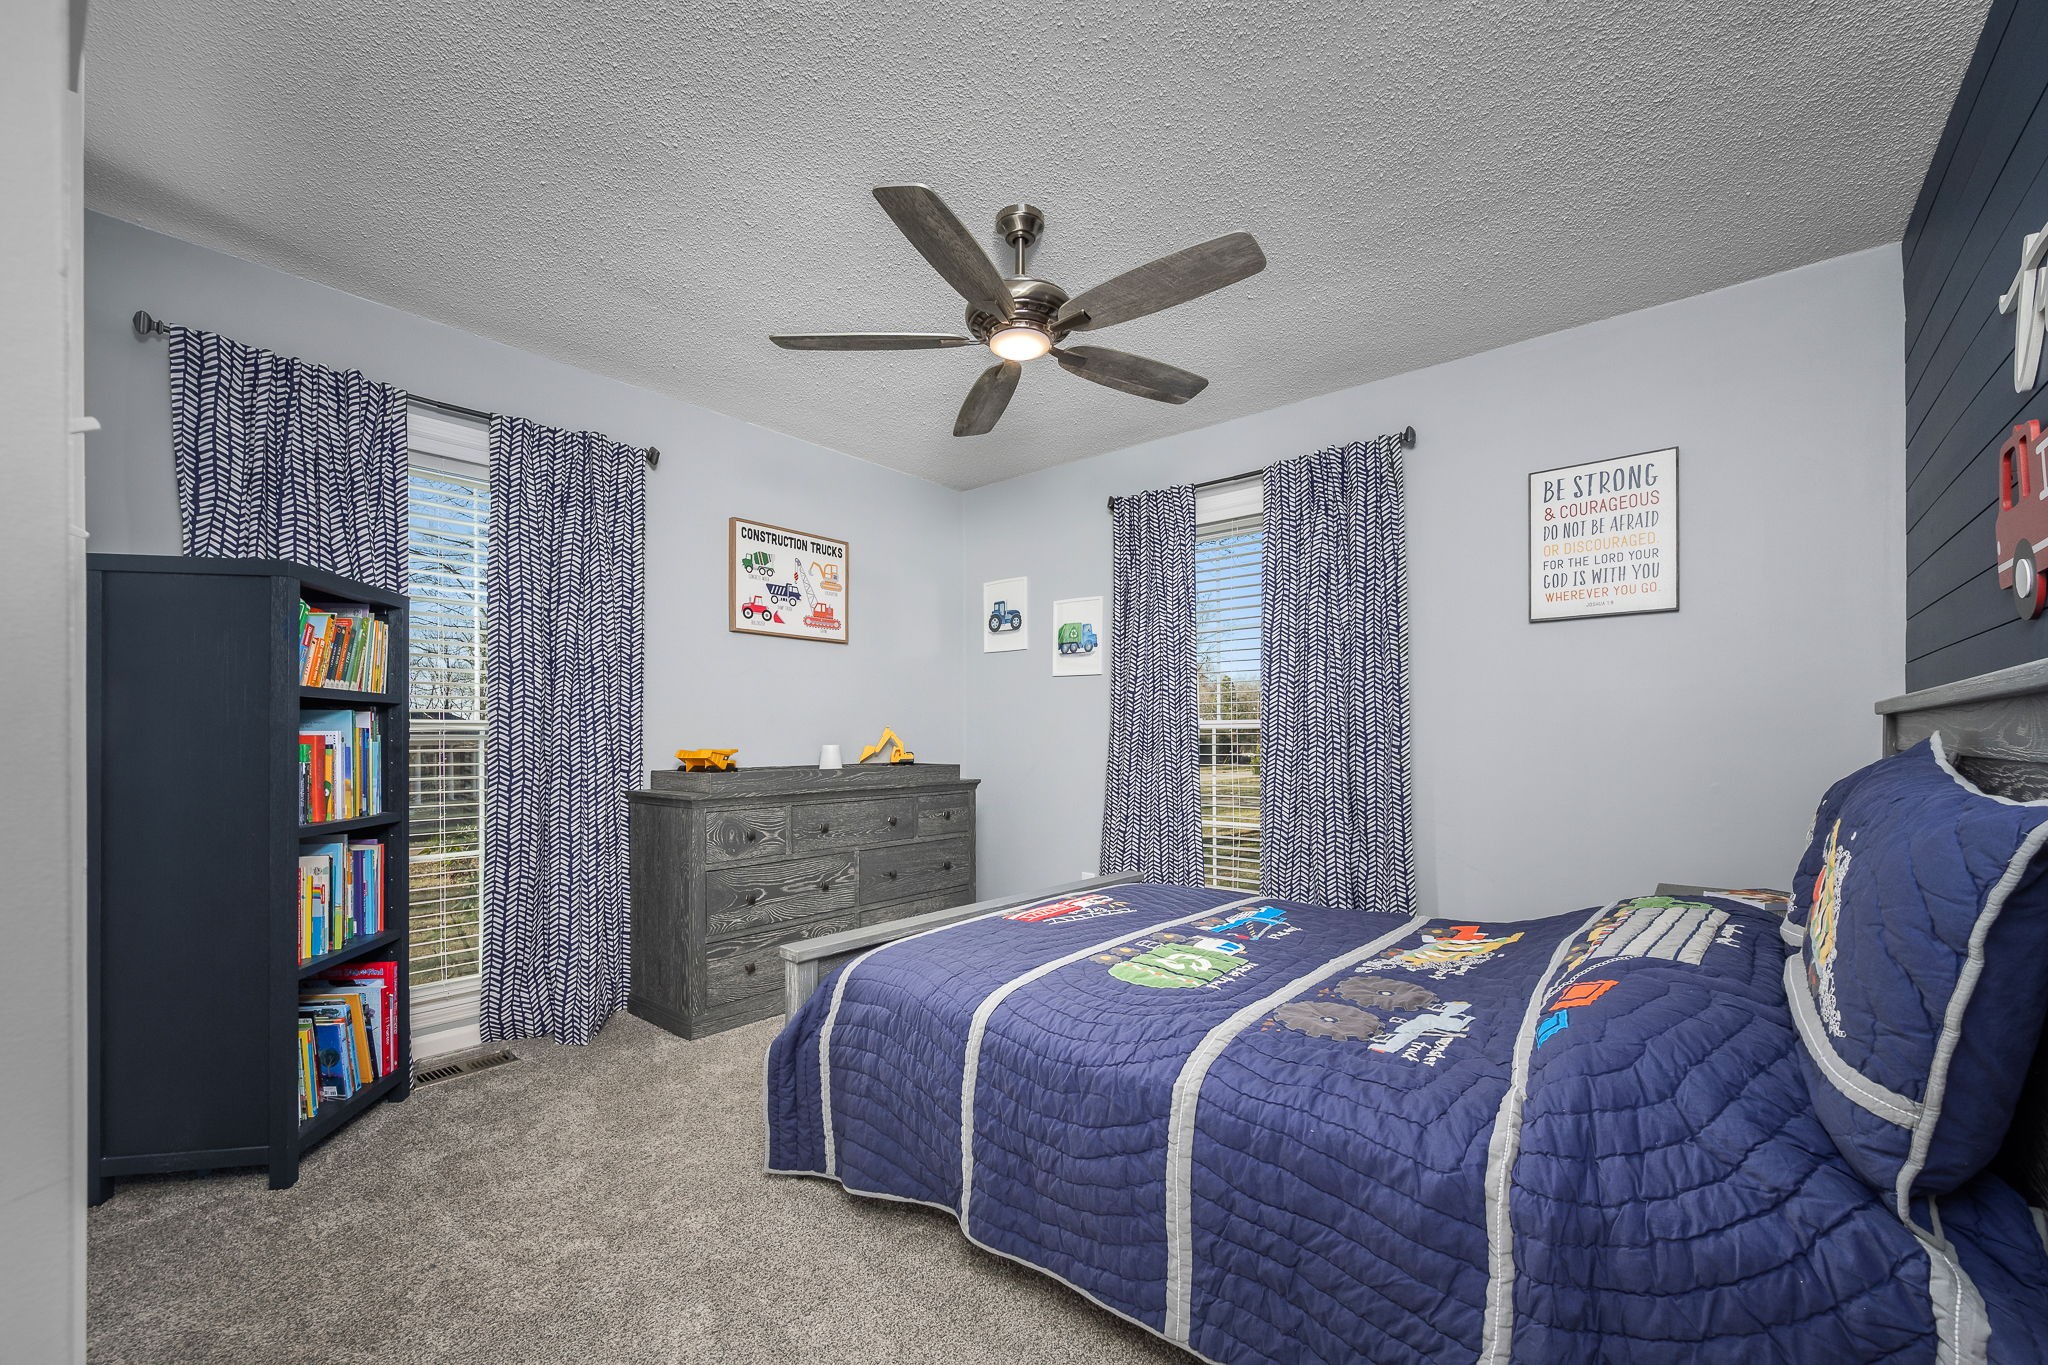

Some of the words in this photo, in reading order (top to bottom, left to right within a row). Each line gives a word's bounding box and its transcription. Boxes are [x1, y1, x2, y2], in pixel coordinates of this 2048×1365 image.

[1543, 478, 1566, 503] BE
[1573, 463, 1659, 498] STRONG
[1544, 507, 1555, 521] &
[1560, 489, 1660, 519] COURAGEOUS
[1543, 524, 1558, 541] DO
[1563, 520, 1587, 539] NOT
[1591, 517, 1605, 535] BE
[1609, 510, 1659, 532] AFRAID
[741, 526, 808, 551] CONSTRUCTION
[810, 541, 843, 558] TRUCKS
[1543, 543, 1560, 558] OR
[1543, 559, 1564, 571] FOR
[1567, 555, 1590, 568] THE
[1594, 551, 1624, 566] LORD
[1628, 547, 1660, 561] YOUR
[1543, 572, 1568, 589] GOD
[1573, 570, 1586, 587] IS
[1592, 565, 1626, 585] WITH
[1631, 561, 1660, 580] YOU
[1545, 586, 1609, 603] WHEREVER
[1613, 583, 1637, 596] YOU
